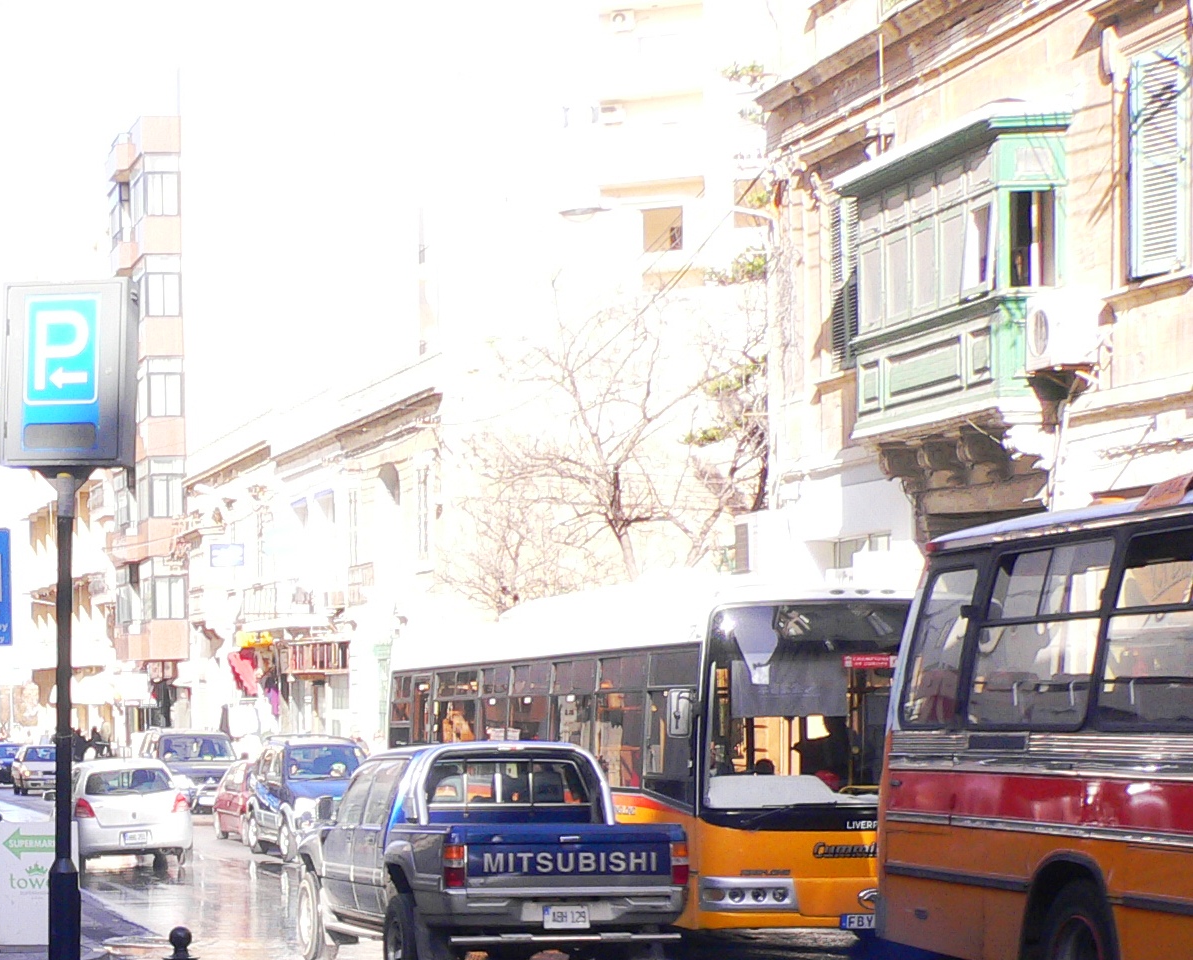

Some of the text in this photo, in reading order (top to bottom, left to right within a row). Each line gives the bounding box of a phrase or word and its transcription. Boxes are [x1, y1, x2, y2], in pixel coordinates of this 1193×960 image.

[34, 310, 89, 391] P
[846, 820, 878, 830] LIVERP
[8, 839, 56, 848] SUPERMAR
[483, 852, 657, 873] MITSUBISHI
[848, 916, 874, 929] FBY
